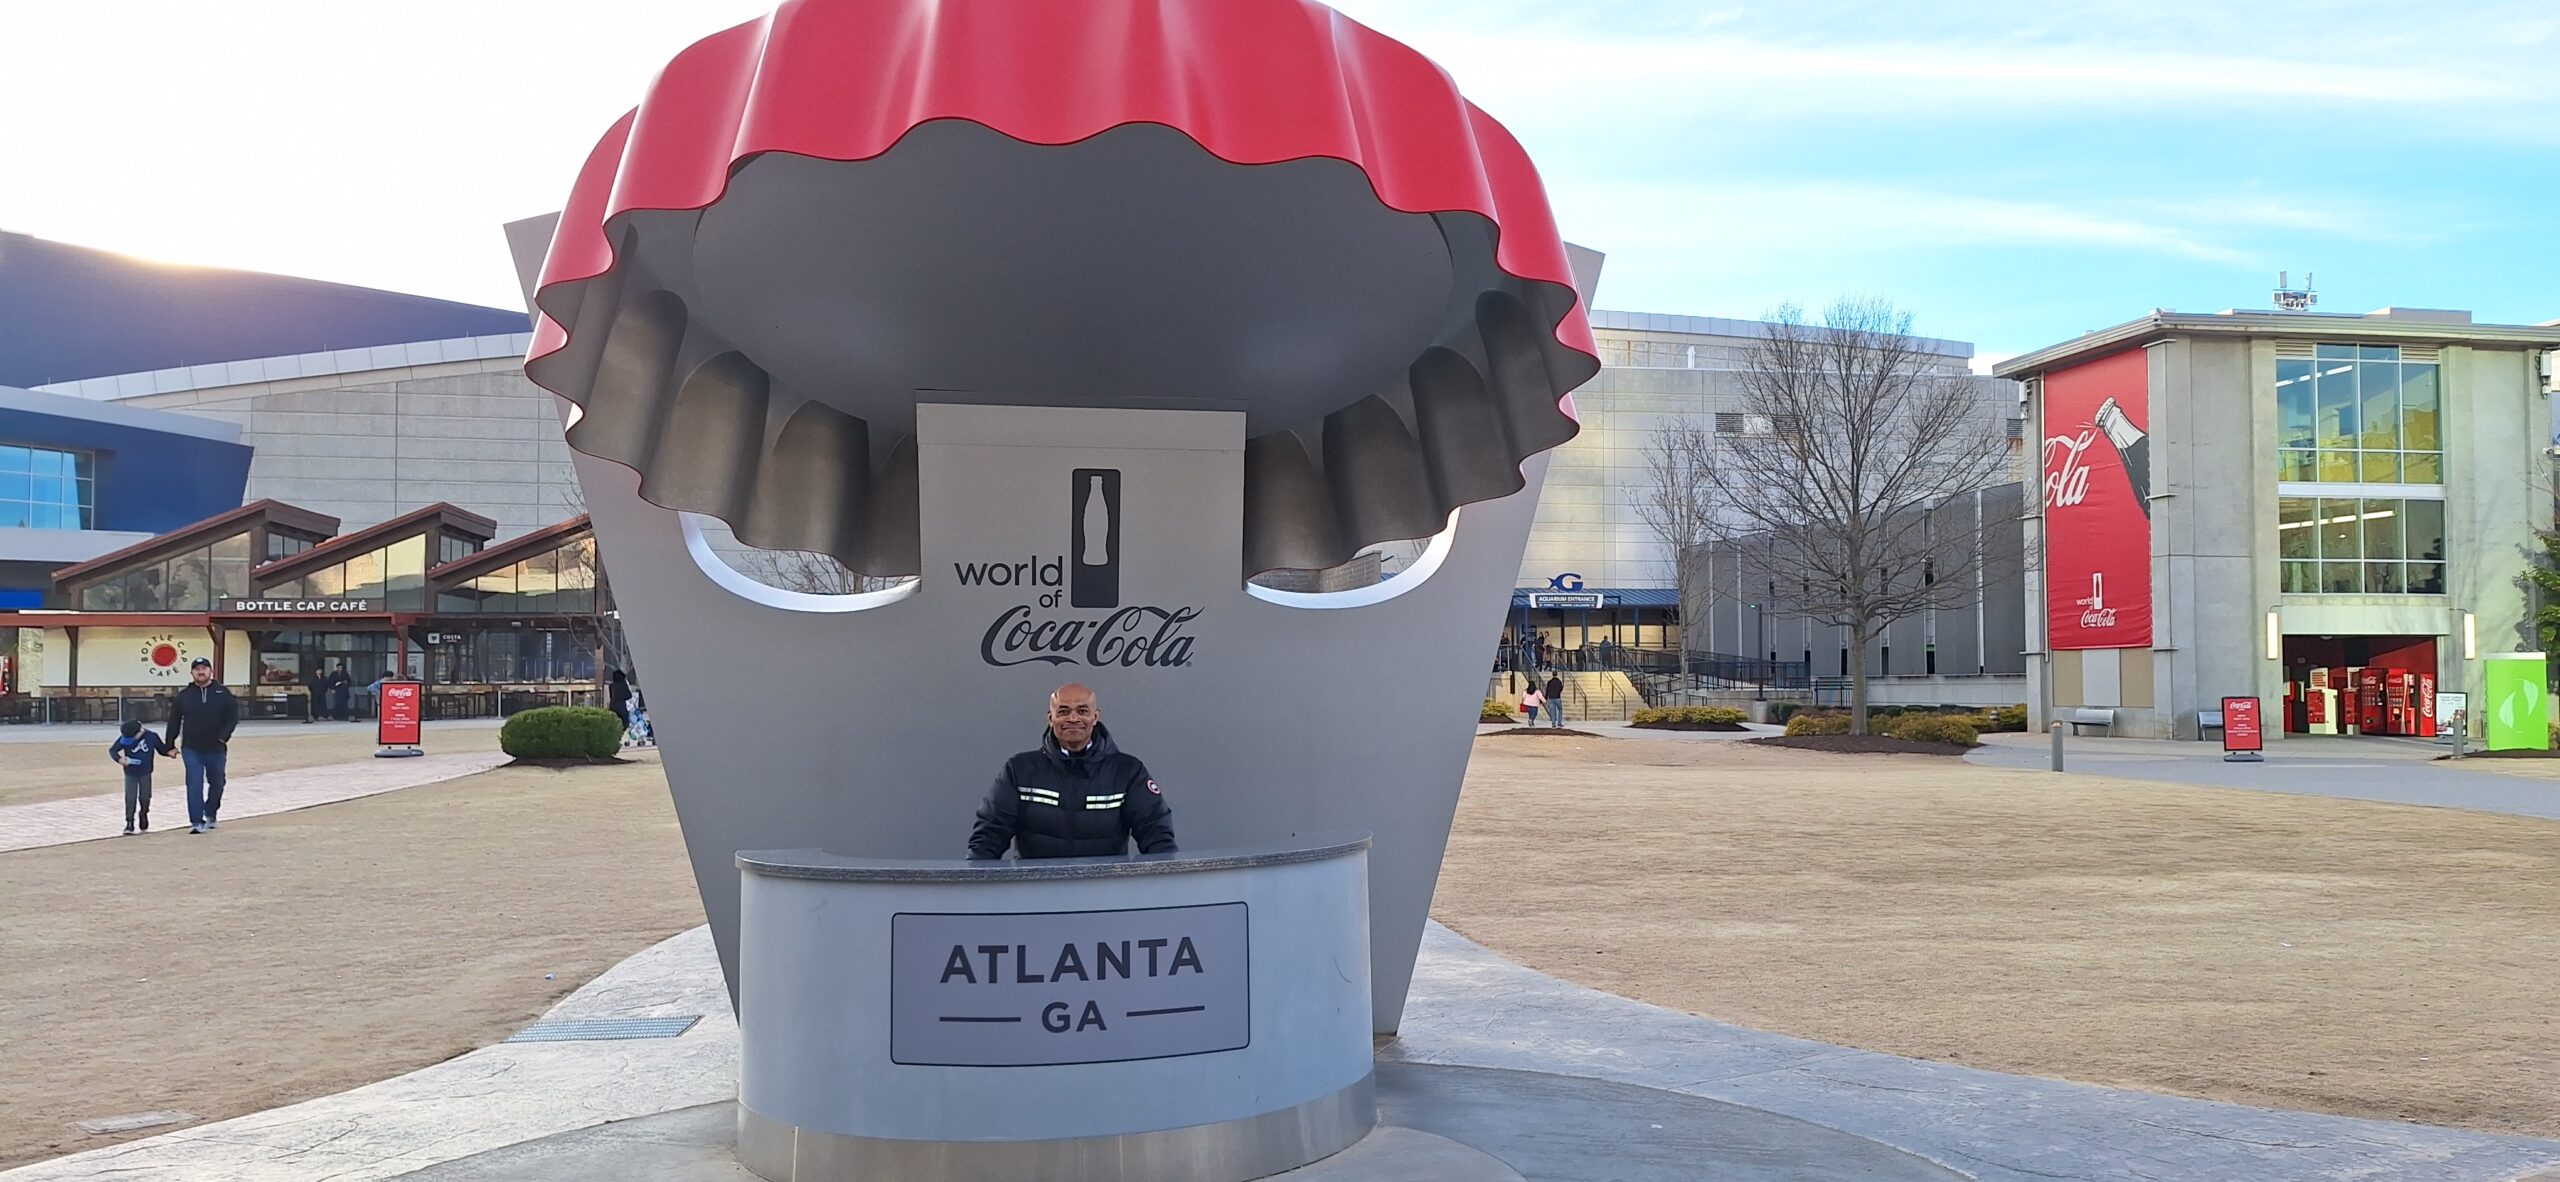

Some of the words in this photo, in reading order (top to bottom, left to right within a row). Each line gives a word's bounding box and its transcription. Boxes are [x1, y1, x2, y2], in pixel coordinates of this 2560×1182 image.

[954, 555, 1063, 587] world
[236, 601, 292, 611] BOTTLE
[296, 601, 326, 611] CAP
[330, 599, 368, 611] CAFÉ
[1038, 589, 1063, 609] of
[2075, 596, 2093, 606] world
[141, 634, 174, 662] BOTTLE
[177, 641, 188, 663] CAP
[980, 604, 1206, 668] Coca-Cola
[940, 936, 1204, 984] ATLANTA
[1041, 1000, 1107, 1034] GA
